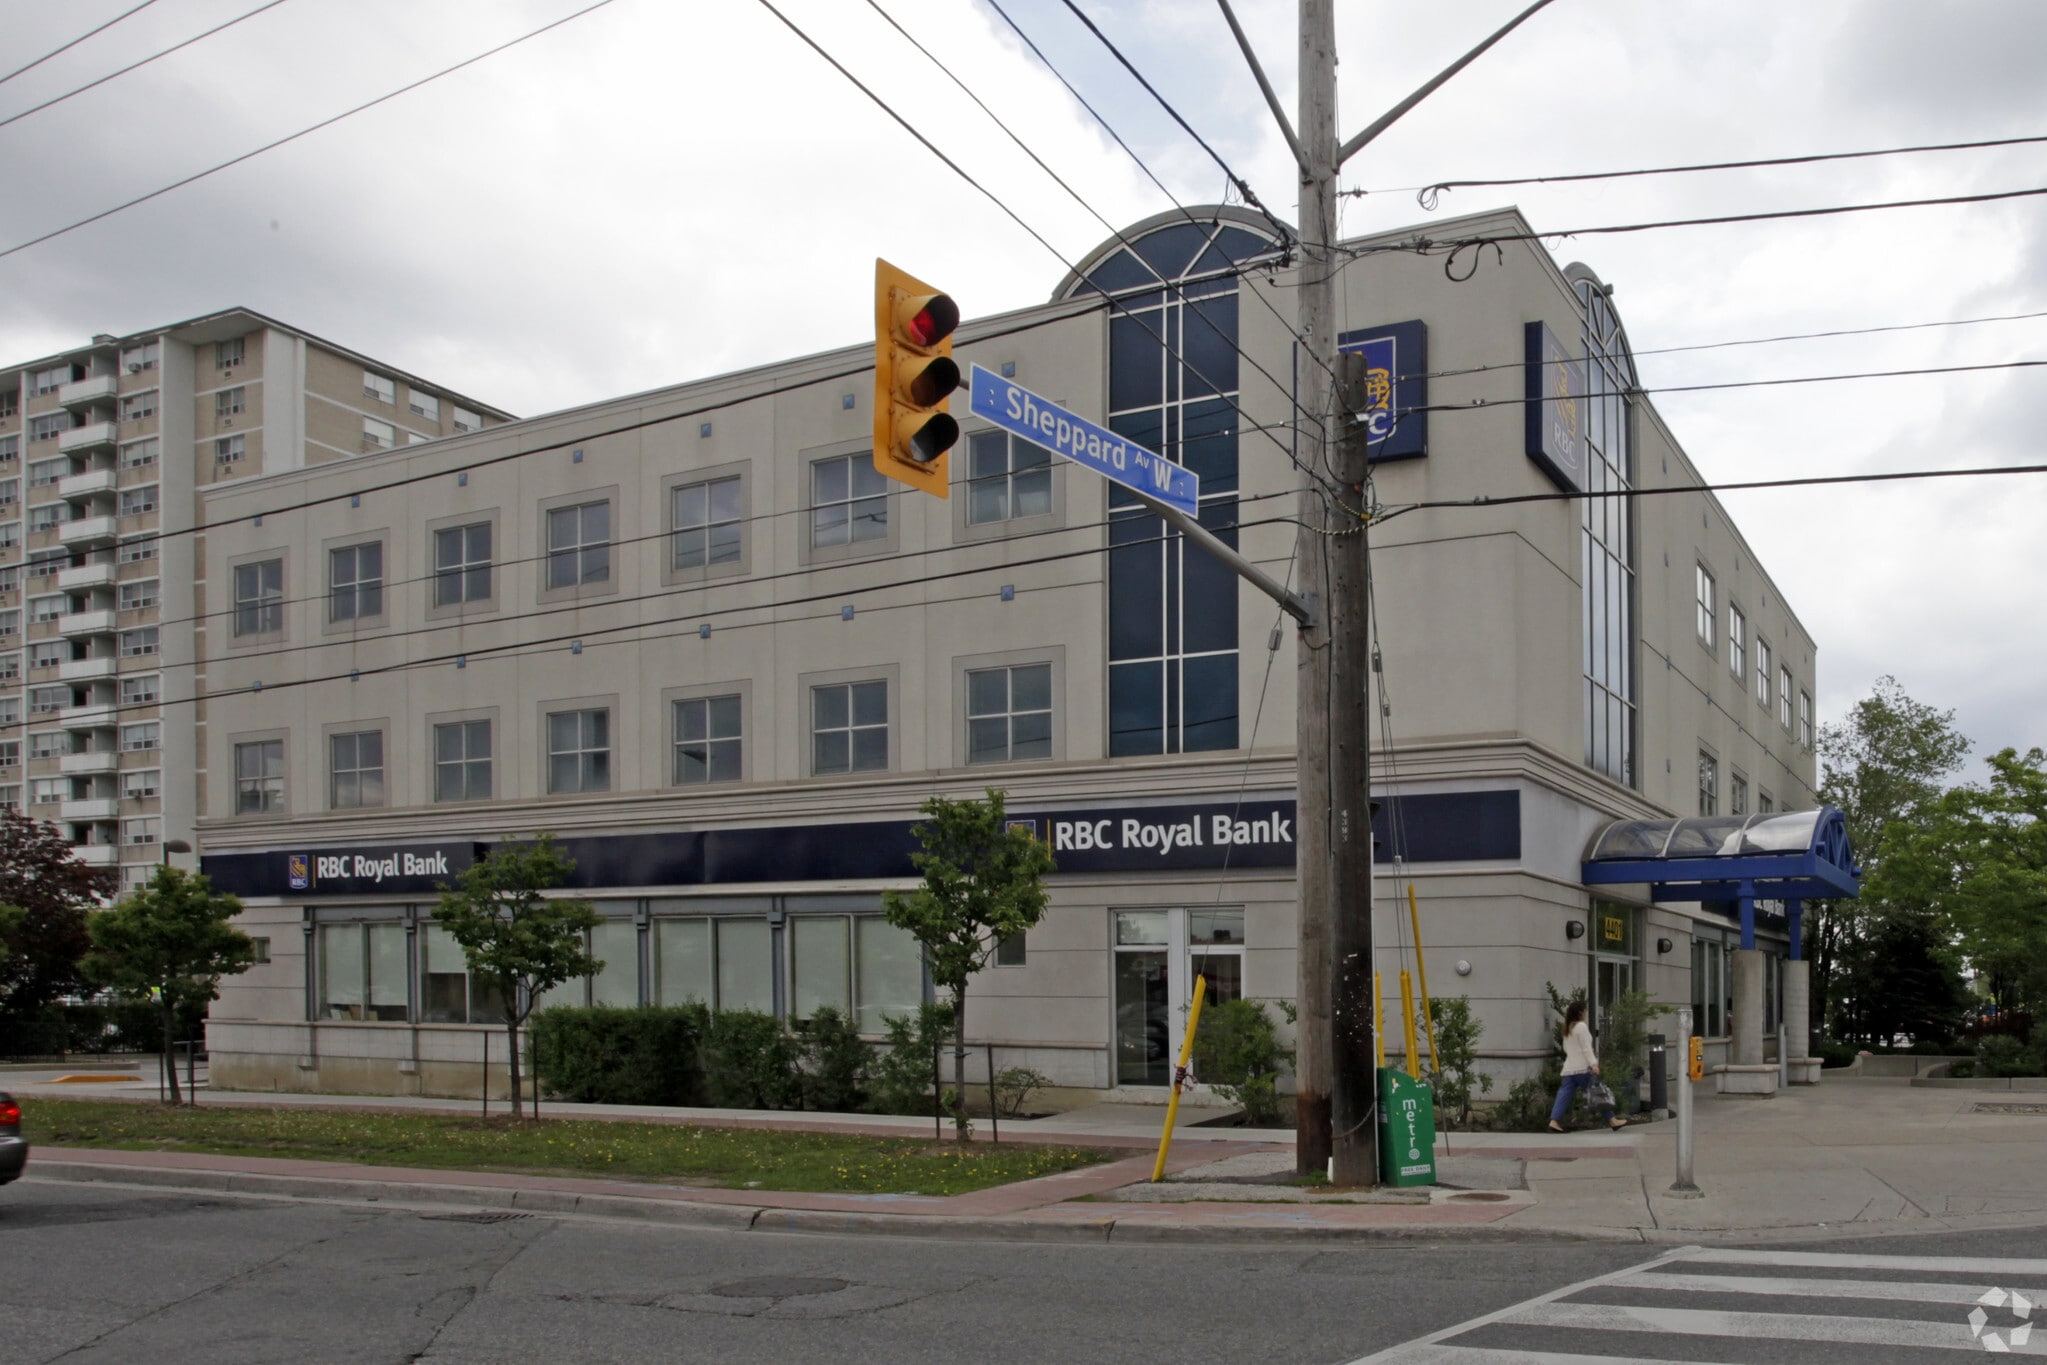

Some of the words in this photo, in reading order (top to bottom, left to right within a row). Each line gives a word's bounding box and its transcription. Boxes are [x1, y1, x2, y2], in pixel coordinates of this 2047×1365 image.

[1006, 386, 1126, 471] Sheppard
[1134, 450, 1150, 469] Av
[1153, 458, 1172, 492] W
[1554, 423, 1576, 463] RBC
[1055, 819, 1113, 851] RBC
[1122, 814, 1203, 856] Royal
[1212, 810, 1293, 845] Bank
[291, 878, 306, 887] RBC
[317, 855, 351, 879] RBC
[354, 852, 399, 883] Royal
[403, 850, 448, 876] Bank
[1606, 919, 1622, 939] 4401
